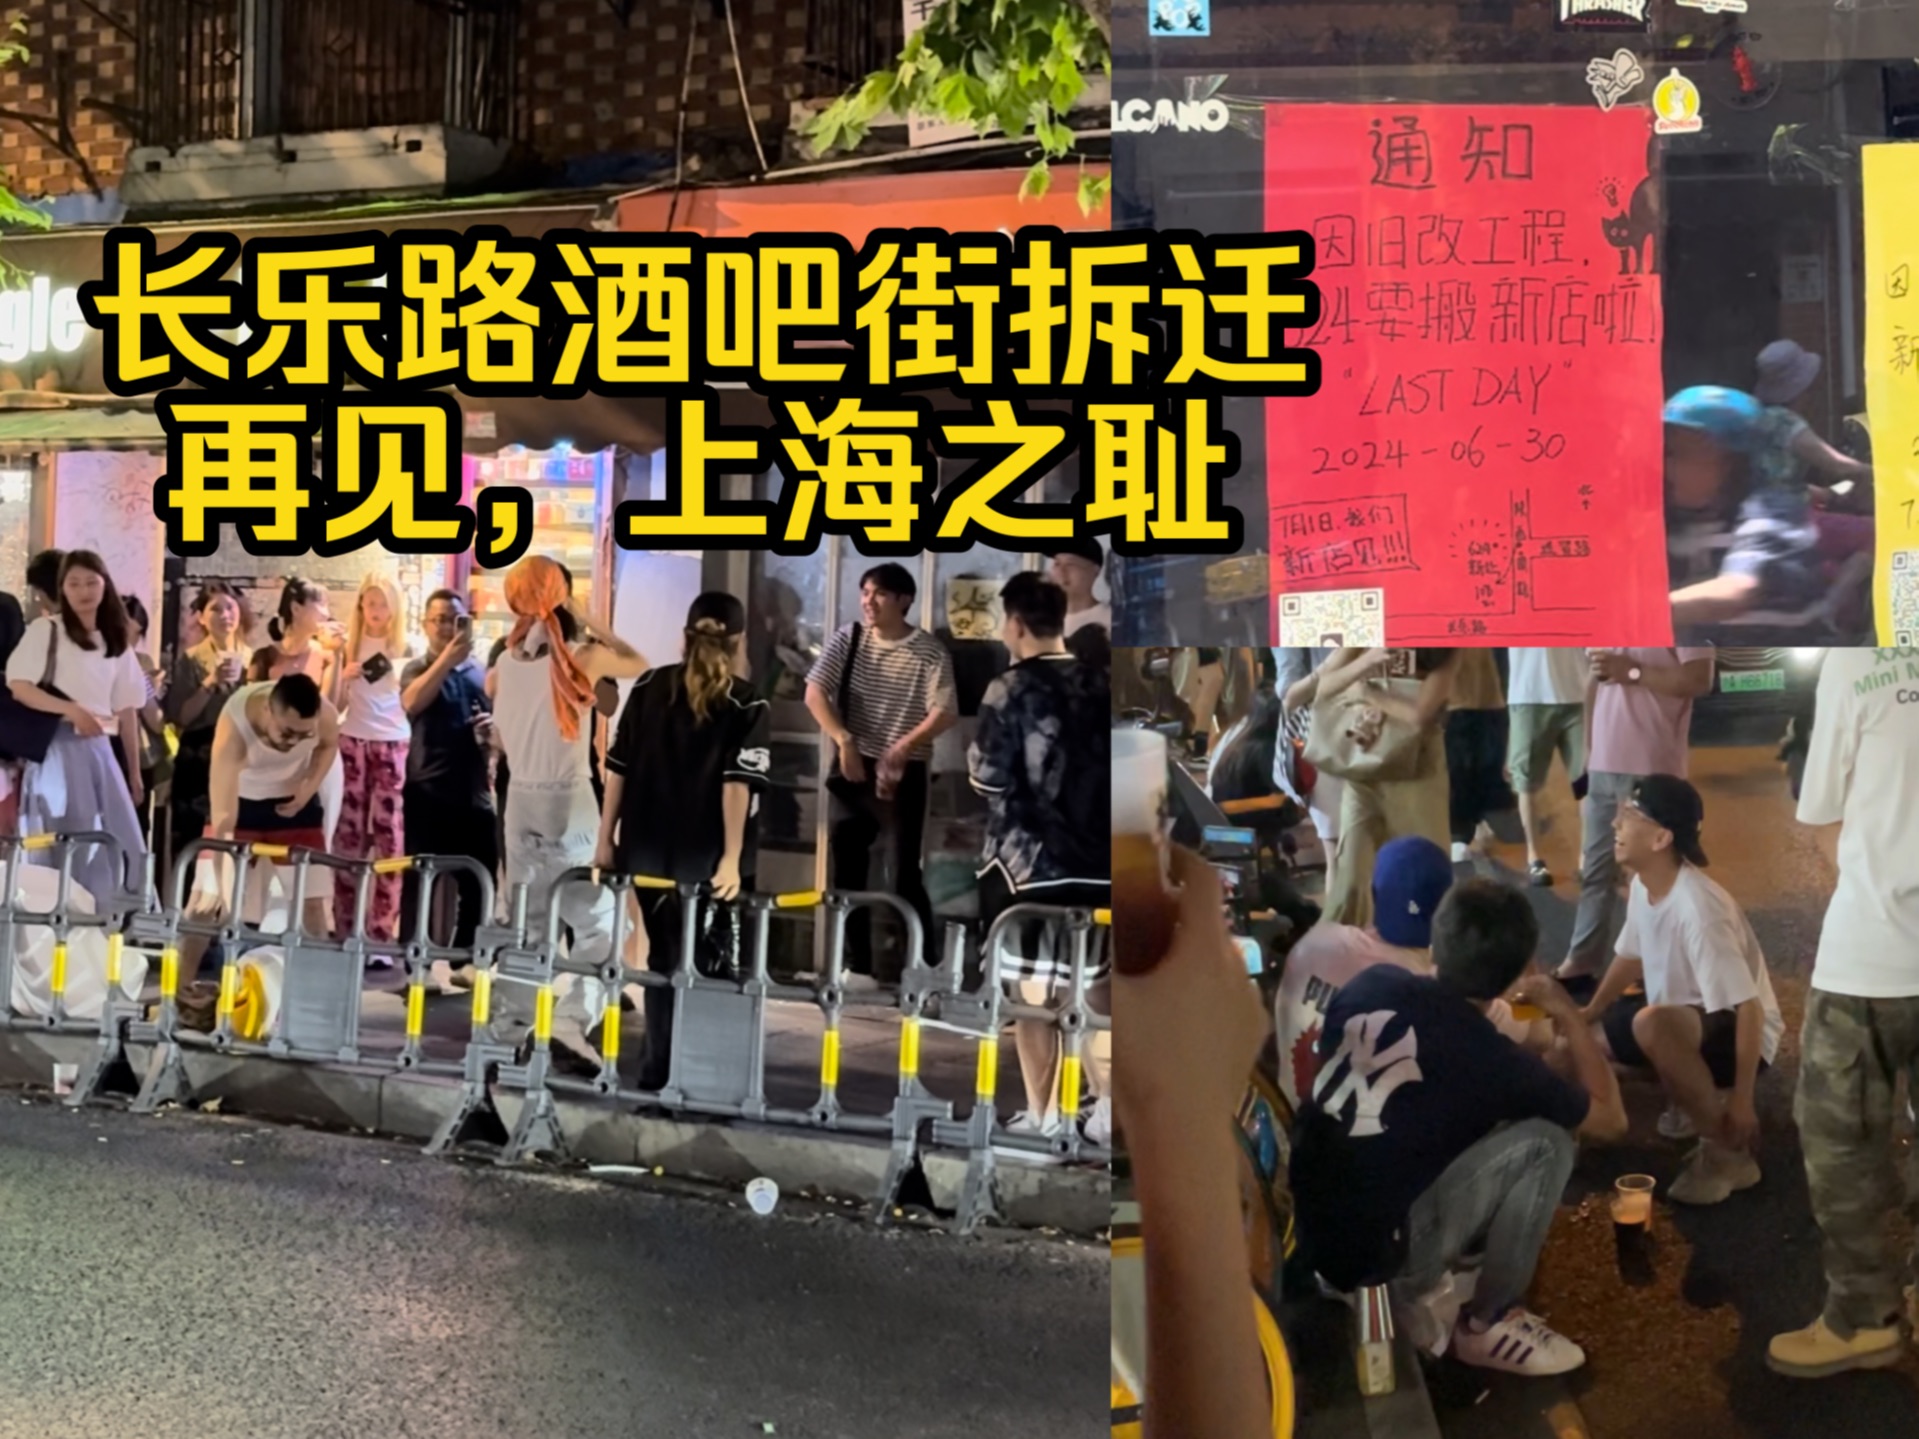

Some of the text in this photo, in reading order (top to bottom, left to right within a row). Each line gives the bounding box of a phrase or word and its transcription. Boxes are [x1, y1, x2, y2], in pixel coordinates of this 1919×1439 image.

[1367, 115, 1534, 190] 通知
[1285, 276, 1656, 349] 24要搬新店啦!
[1853, 665, 1899, 697] Mini
